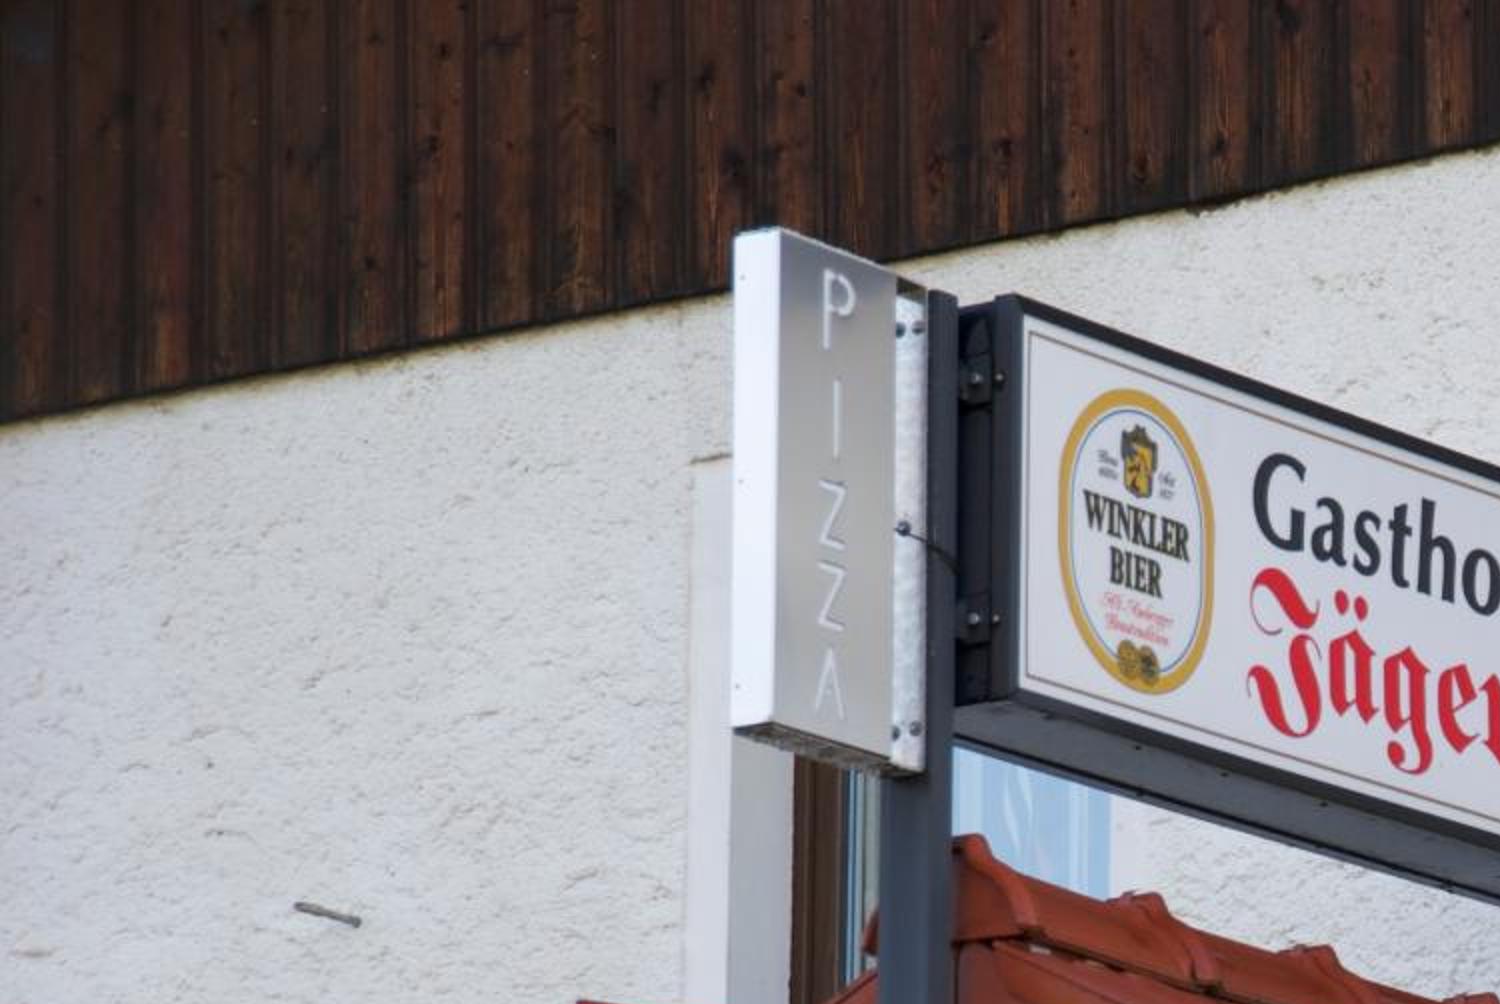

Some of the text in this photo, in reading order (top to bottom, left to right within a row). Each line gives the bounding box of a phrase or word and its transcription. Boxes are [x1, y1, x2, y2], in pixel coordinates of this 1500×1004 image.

[815, 268, 856, 720] PIZZA
[1082, 488, 1190, 563] WINKLER
[1109, 545, 1164, 599] BIER
